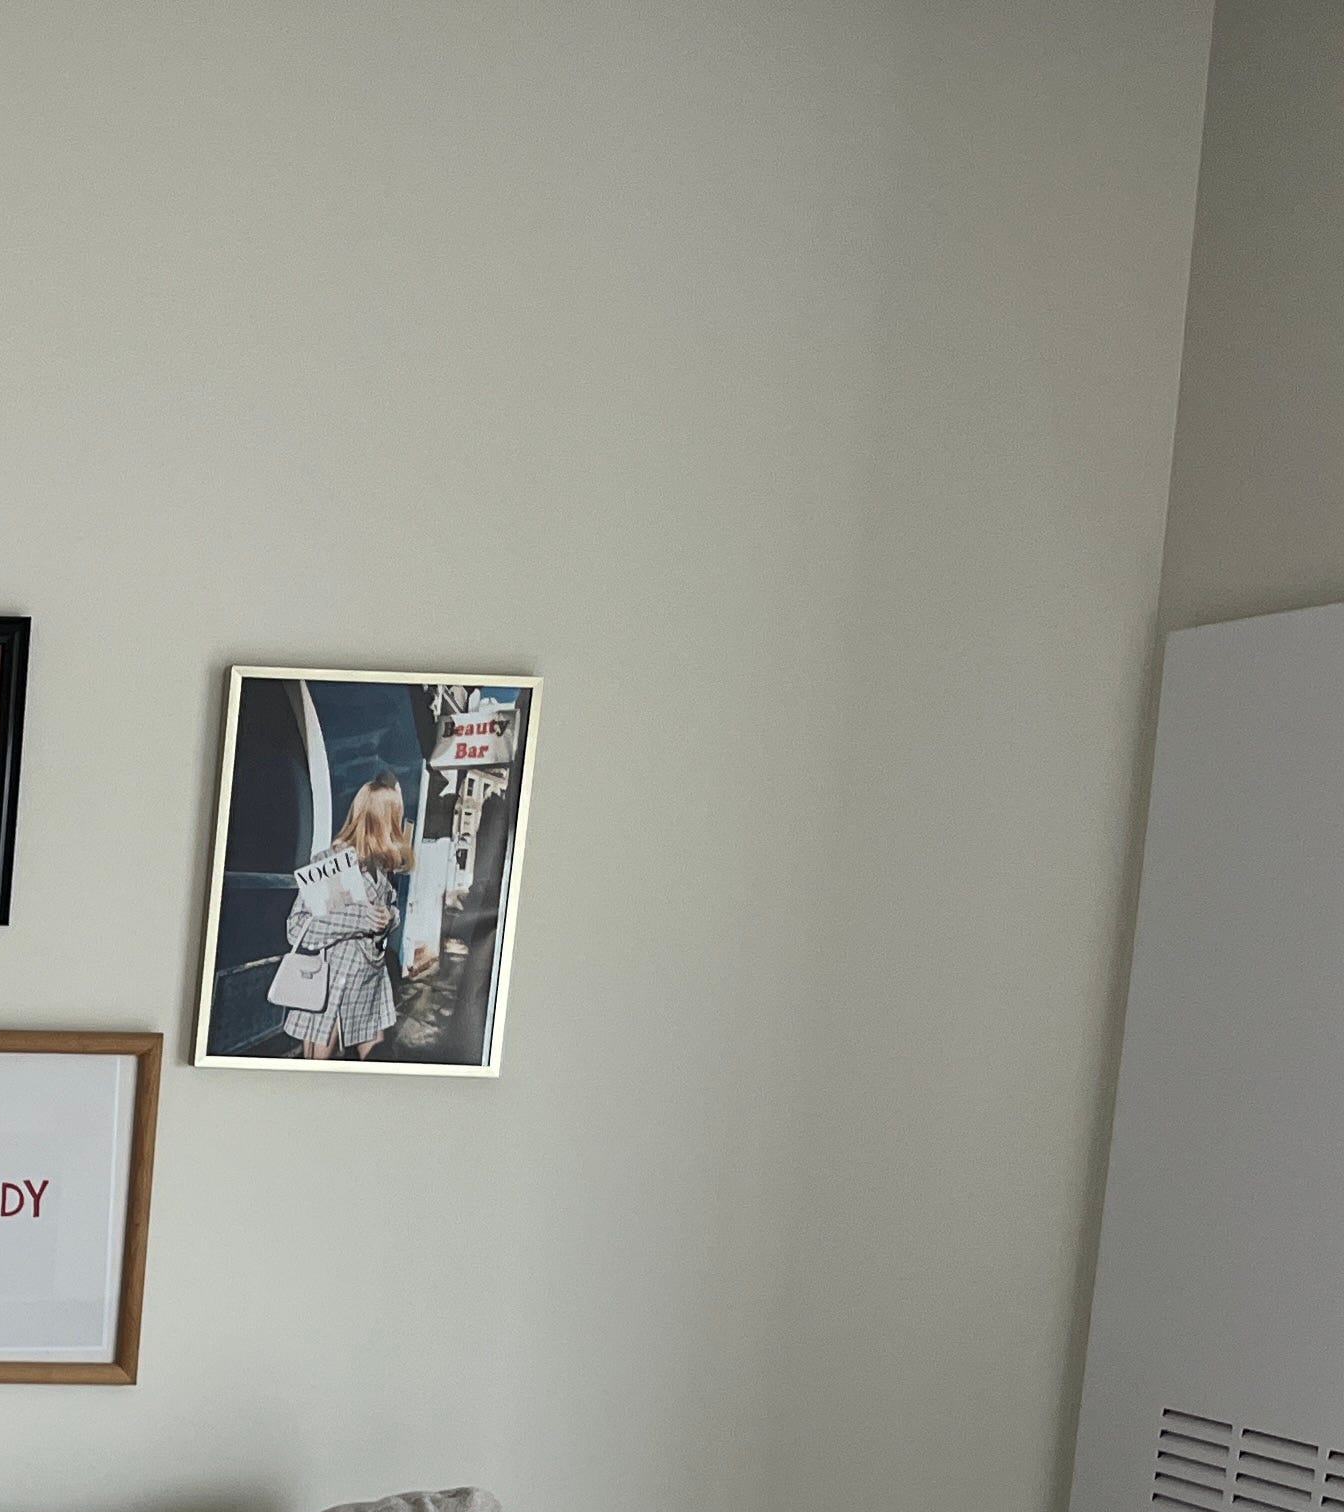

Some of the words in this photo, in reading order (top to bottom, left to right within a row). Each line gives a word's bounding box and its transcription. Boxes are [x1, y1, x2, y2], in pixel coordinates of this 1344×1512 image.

[442, 719, 511, 738] Beauty
[455, 742, 489, 760] Bar
[297, 849, 358, 885] VOGUE
